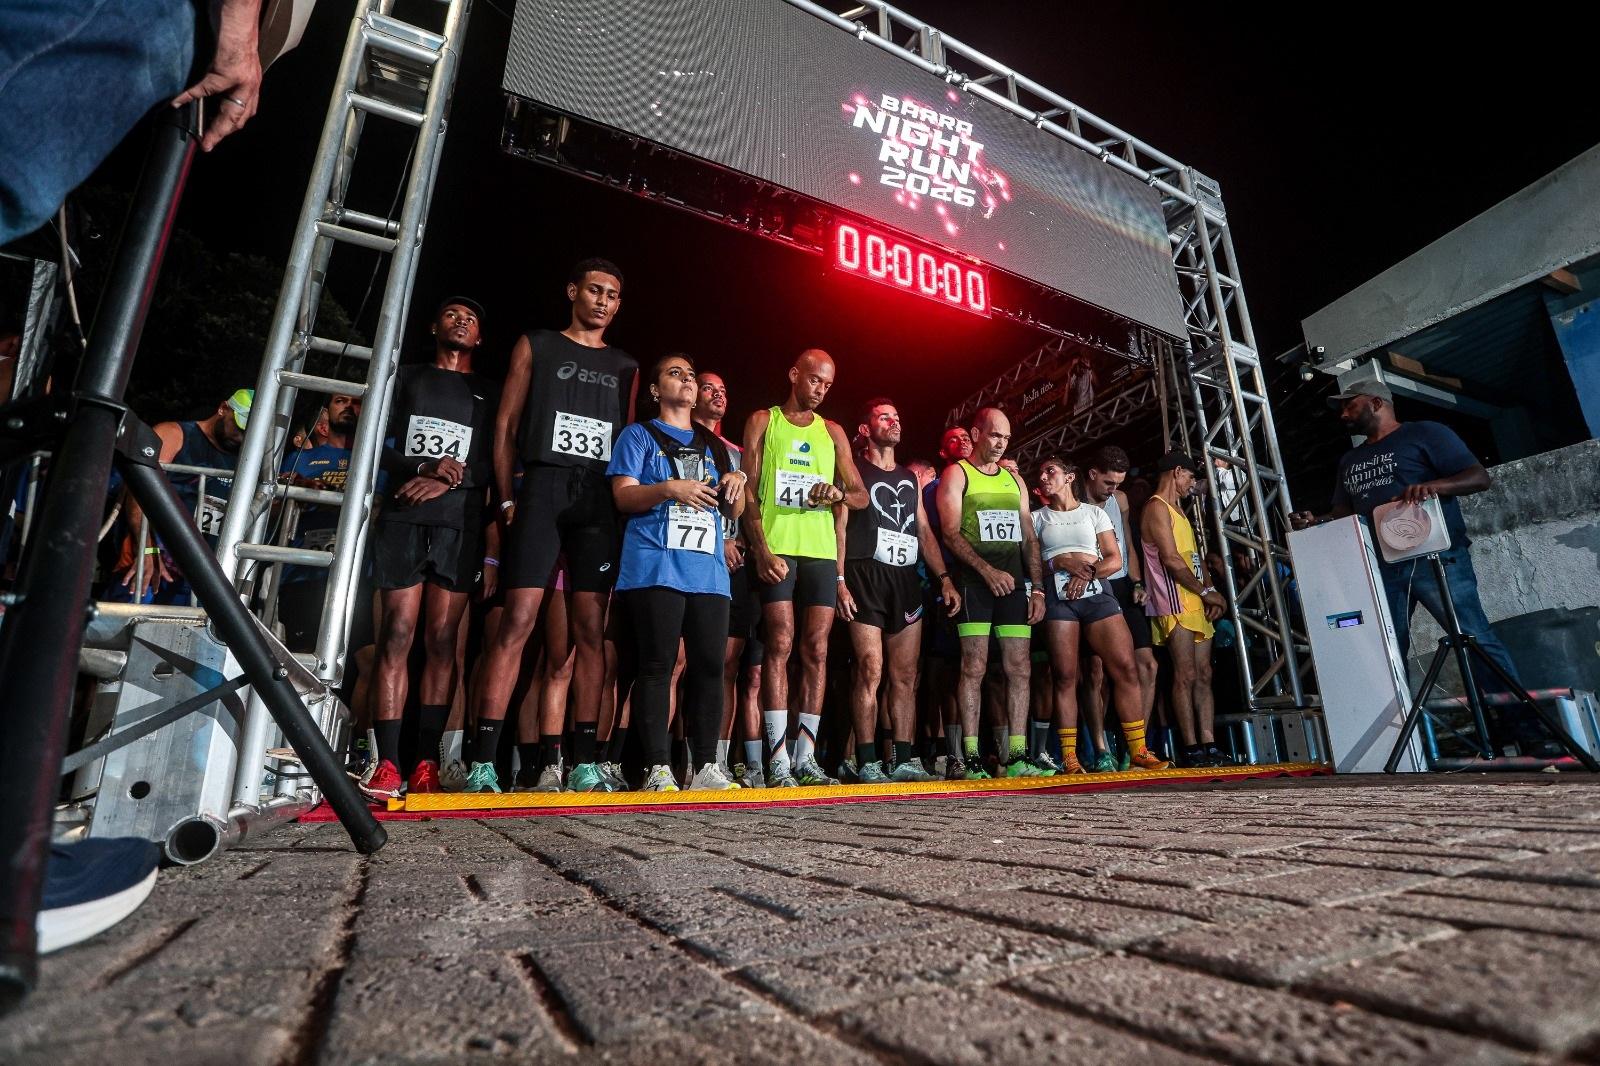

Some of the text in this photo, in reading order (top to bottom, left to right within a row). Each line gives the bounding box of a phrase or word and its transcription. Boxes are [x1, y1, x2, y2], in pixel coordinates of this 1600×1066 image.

[881, 94, 973, 136] BARRA
[853, 104, 984, 161] NIGHT
[879, 138, 970, 185] RUN
[880, 166, 977, 207] 2026
[578, 368, 619, 388] asics
[410, 433, 461, 459] 334
[557, 430, 604, 459] 333
[677, 524, 708, 549] 77
[985, 523, 1015, 540] 167
[887, 545, 907, 566] 15
